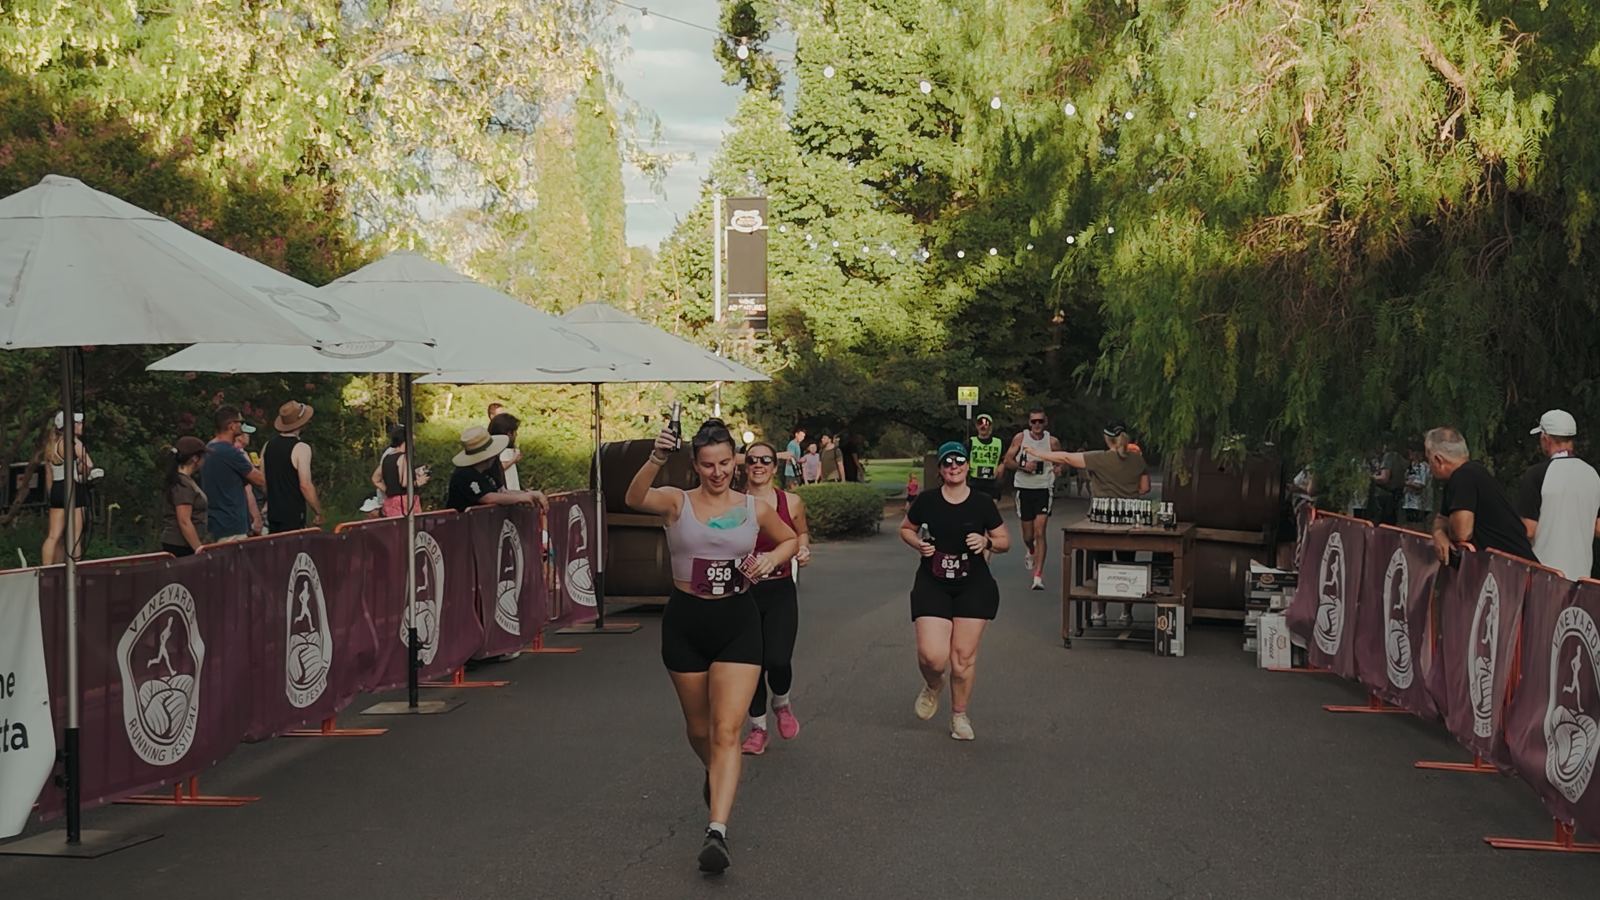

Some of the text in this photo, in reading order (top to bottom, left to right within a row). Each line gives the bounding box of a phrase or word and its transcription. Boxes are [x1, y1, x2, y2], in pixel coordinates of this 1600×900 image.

[972, 451, 999, 461] 1:45
[707, 567, 732, 581] 958
[941, 559, 960, 570] 834
[129, 585, 196, 633] VINEYARDS
[128, 717, 166, 762] RUNNING
[171, 703, 197, 760] FESTIVAL
